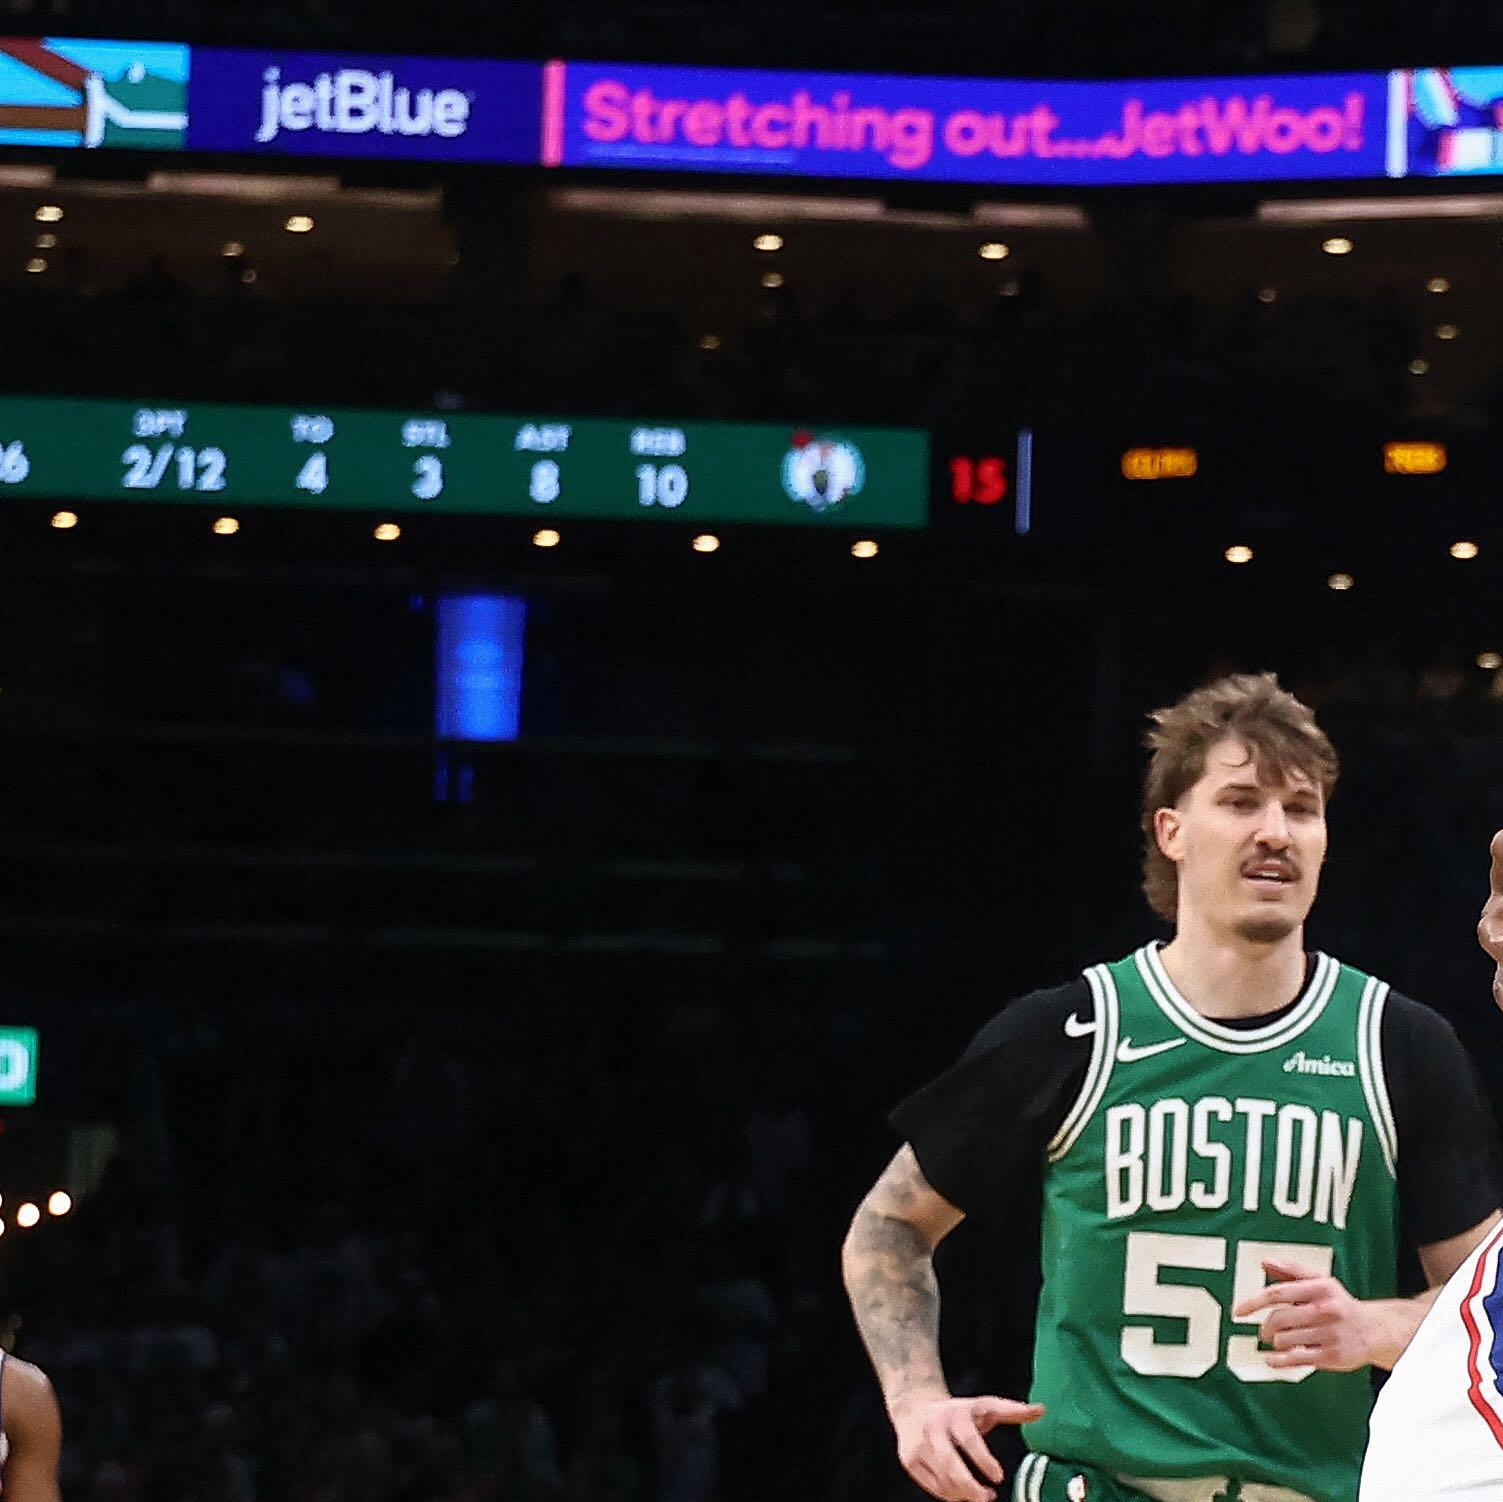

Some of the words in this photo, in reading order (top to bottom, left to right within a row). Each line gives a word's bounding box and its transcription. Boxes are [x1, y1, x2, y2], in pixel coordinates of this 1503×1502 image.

[257, 67, 469, 142] jetBlue
[582, 80, 935, 169] Stretching
[0, 440, 30, 484] 6
[123, 444, 227, 492] 2/12
[297, 451, 328, 494] 4
[411, 455, 444, 500] 3
[638, 463, 688, 508] 10
[1282, 1050, 1356, 1076] Amica
[1105, 1096, 1363, 1230] BOSTON
[1120, 1232, 1334, 1384] 55
